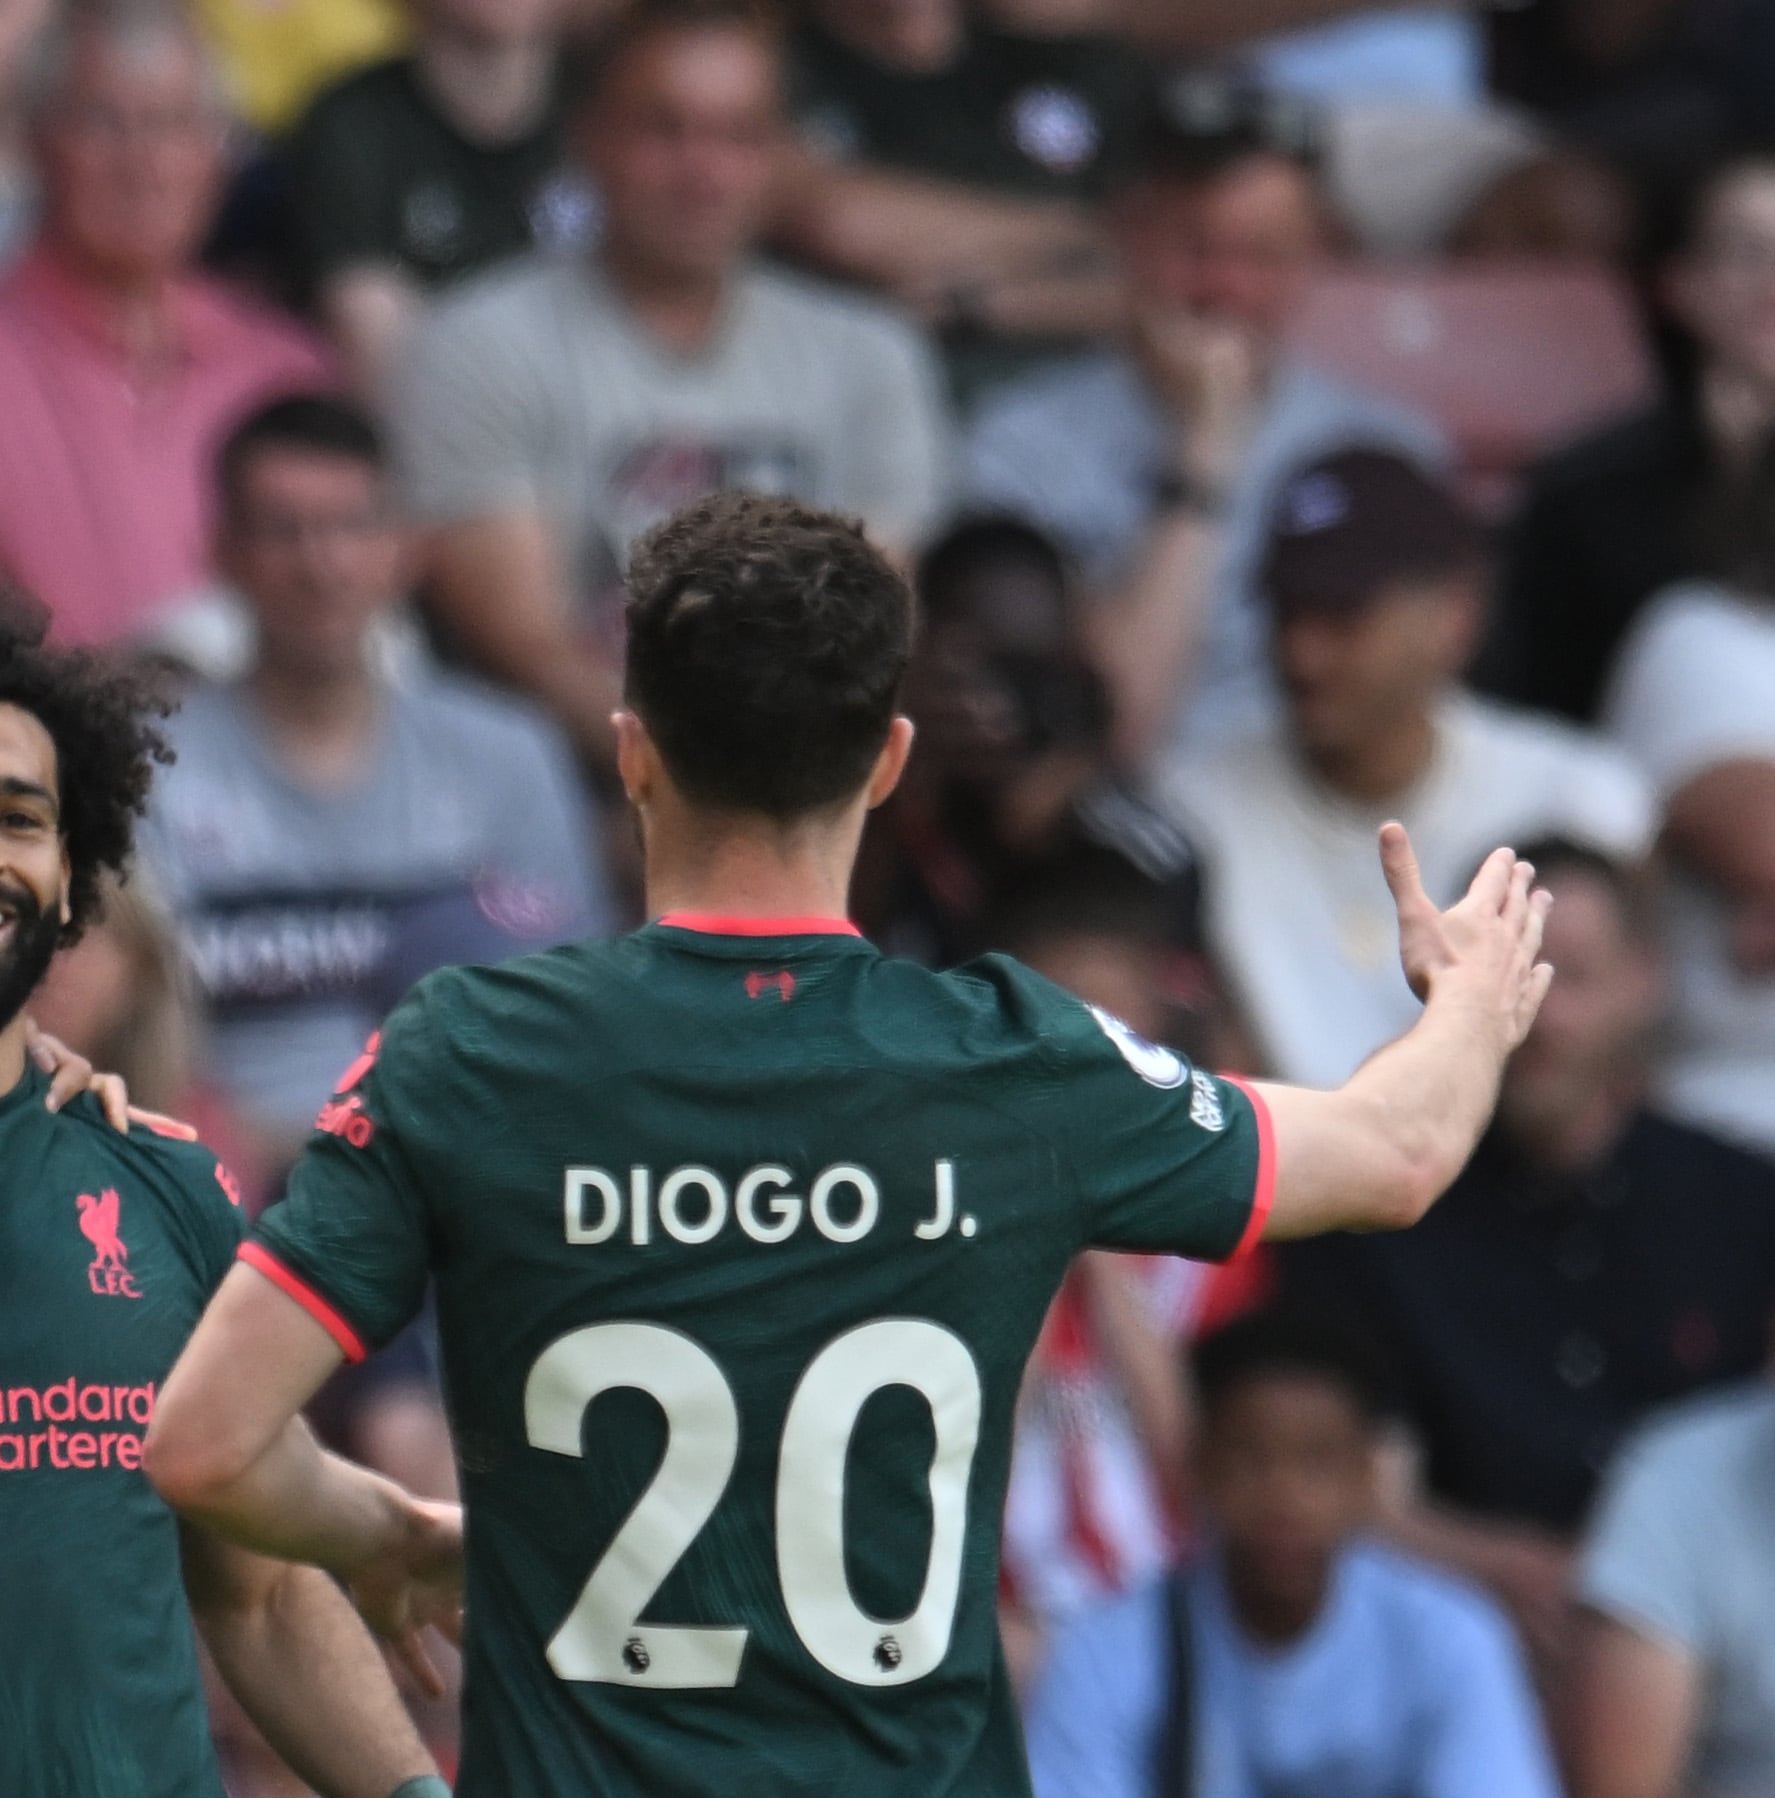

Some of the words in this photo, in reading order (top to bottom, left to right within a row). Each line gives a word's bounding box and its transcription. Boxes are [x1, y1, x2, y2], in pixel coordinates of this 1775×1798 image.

[564, 1165, 880, 1246] DIOGO
[914, 1160, 976, 1240] J.
[525, 1319, 982, 1688] 20
